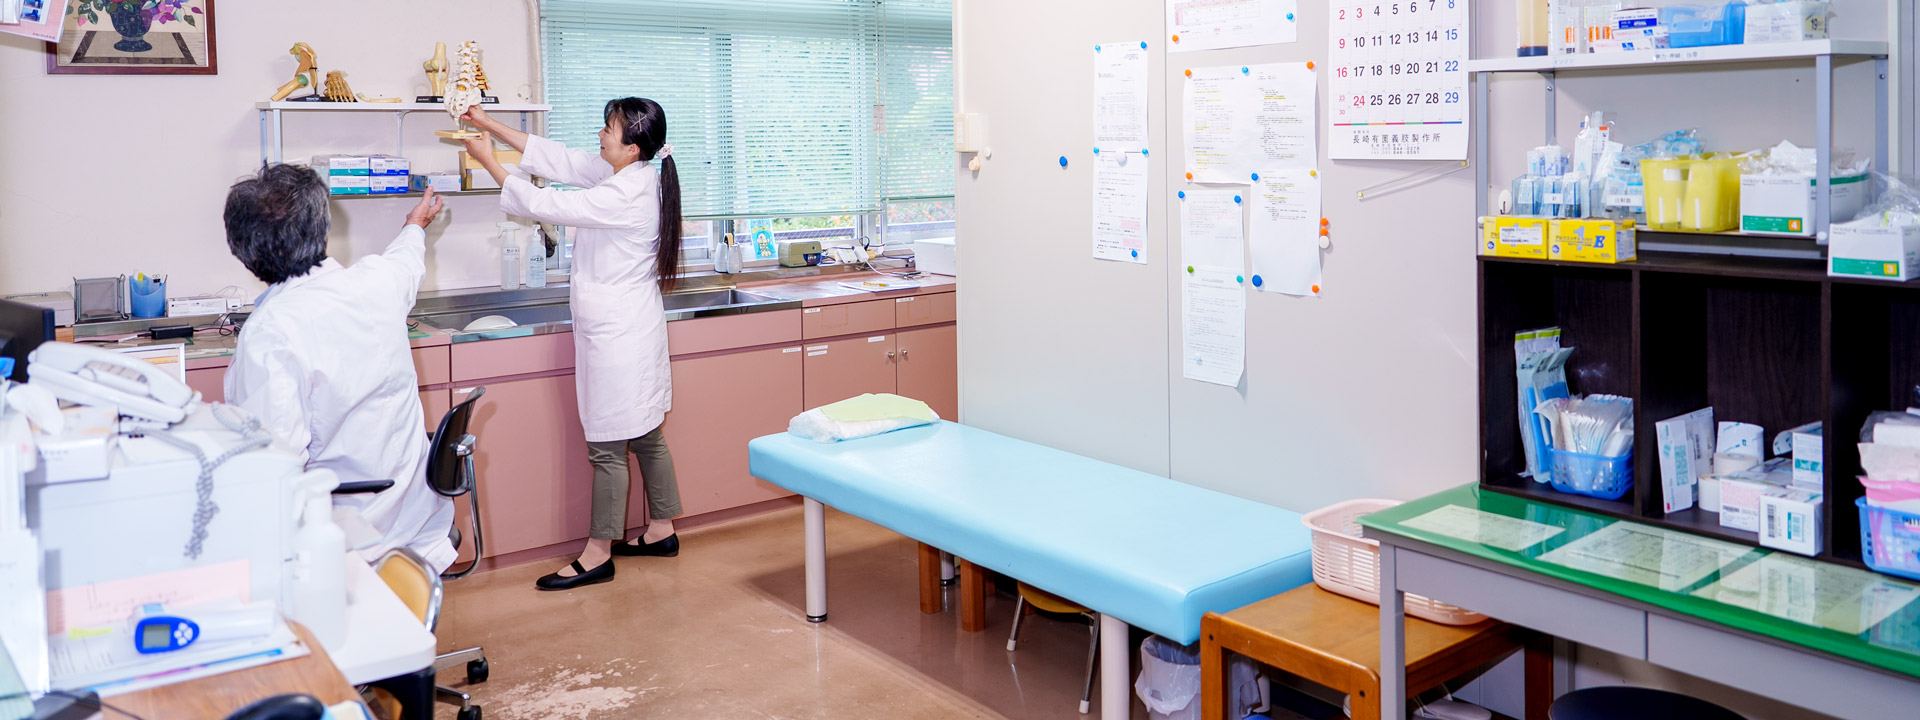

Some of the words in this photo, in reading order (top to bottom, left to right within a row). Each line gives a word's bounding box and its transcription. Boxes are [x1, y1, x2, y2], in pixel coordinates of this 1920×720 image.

[1339, 9, 1345, 20] 2
[1356, 7, 1363, 18] 3
[1373, 5, 1380, 16] 4
[1392, 4, 1399, 15] 5
[1410, 2, 1417, 13] 6
[1448, 0, 1455, 9] 8
[1339, 38, 1345, 49] 9
[1353, 36, 1365, 48] 10
[1371, 35, 1382, 46] 11
[1389, 34, 1401, 45] 12
[1407, 32, 1419, 43] 13
[1426, 30, 1438, 42] 14
[1445, 29, 1458, 40] 15
[1336, 67, 1348, 78] 16
[1354, 66, 1365, 77] 17
[1371, 65, 1383, 76] 18
[1389, 64, 1401, 75] 19
[1406, 62, 1420, 74] 20
[1425, 61, 1439, 73] 21
[1444, 60, 1459, 72] 22
[1353, 95, 1365, 106] 24
[1370, 95, 1383, 106] 25
[1388, 94, 1401, 105] 26
[1406, 93, 1420, 104] 27
[1425, 93, 1439, 104] 28
[1445, 92, 1459, 103] 29
[1790, 221, 1798, 230] 4
[1593, 235, 1606, 248] E
